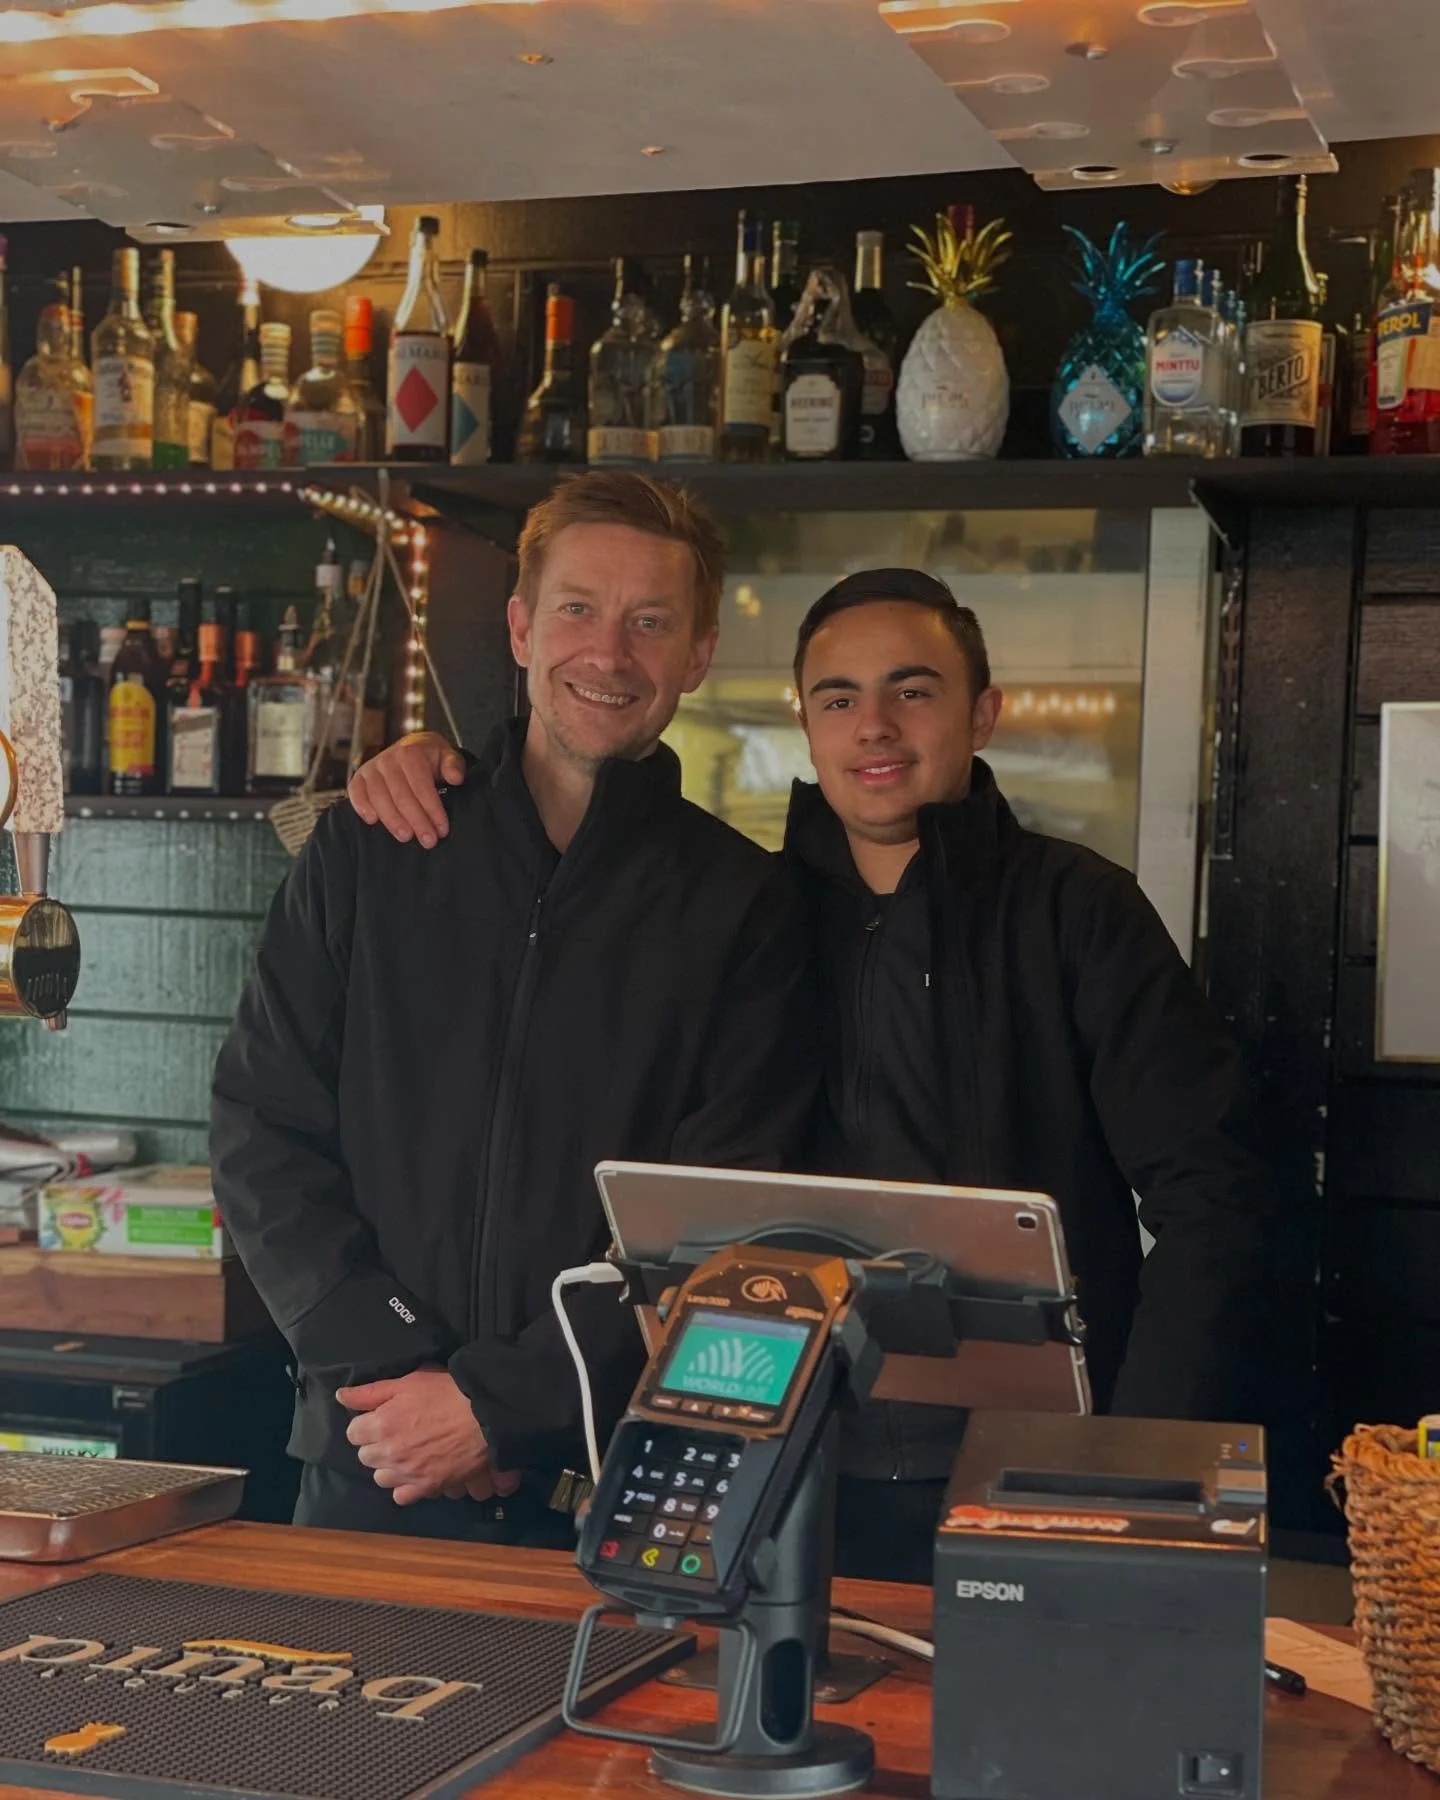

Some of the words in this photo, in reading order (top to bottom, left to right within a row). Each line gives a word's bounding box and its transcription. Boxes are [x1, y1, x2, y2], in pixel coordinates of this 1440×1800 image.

[1155, 359, 1200, 372] MINTTU
[1258, 355, 1305, 401] BERTO
[645, 1439, 654, 1454] 1
[683, 1447, 697, 1462] 2
[727, 1453, 741, 1468] 3
[632, 1464, 643, 1478] 4
[673, 1472, 687, 1487] 5
[716, 1479, 729, 1494] 6
[623, 1490, 636, 1504] 7
[663, 1497, 678, 1513] 8
[706, 1504, 720, 1521] 9
[653, 1522, 667, 1539] 0
[956, 1580, 1025, 1602] EPSON
